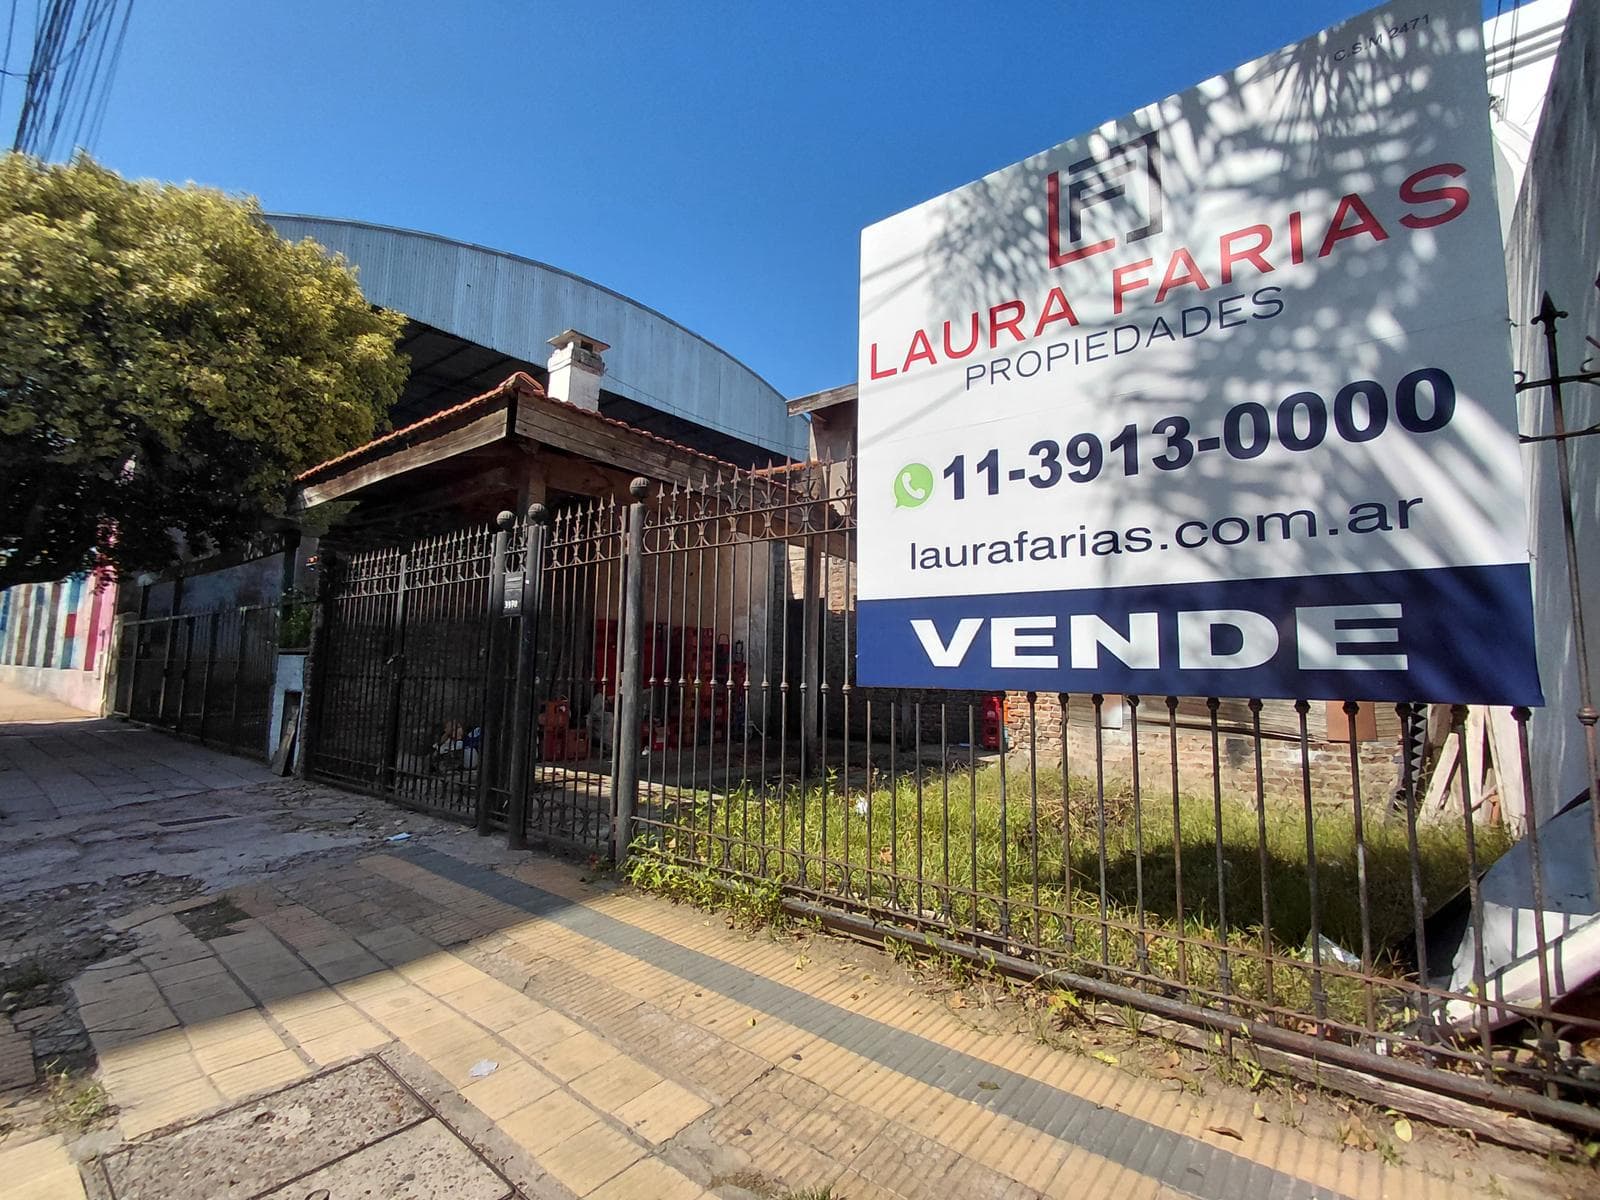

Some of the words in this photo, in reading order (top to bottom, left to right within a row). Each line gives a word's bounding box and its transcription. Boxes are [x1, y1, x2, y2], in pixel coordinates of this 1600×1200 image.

[1334, 33, 1383, 62] C.S.M
[1388, 14, 1430, 40] 2471
[870, 287, 1079, 381] LAURA
[1113, 162, 1471, 316] FARIAS
[966, 286, 1285, 391] PROPIEDADES
[942, 367, 1457, 501] 11-3913-0000
[910, 497, 1424, 571] laurafarias.com.ar
[909, 603, 1409, 671] VENDE
